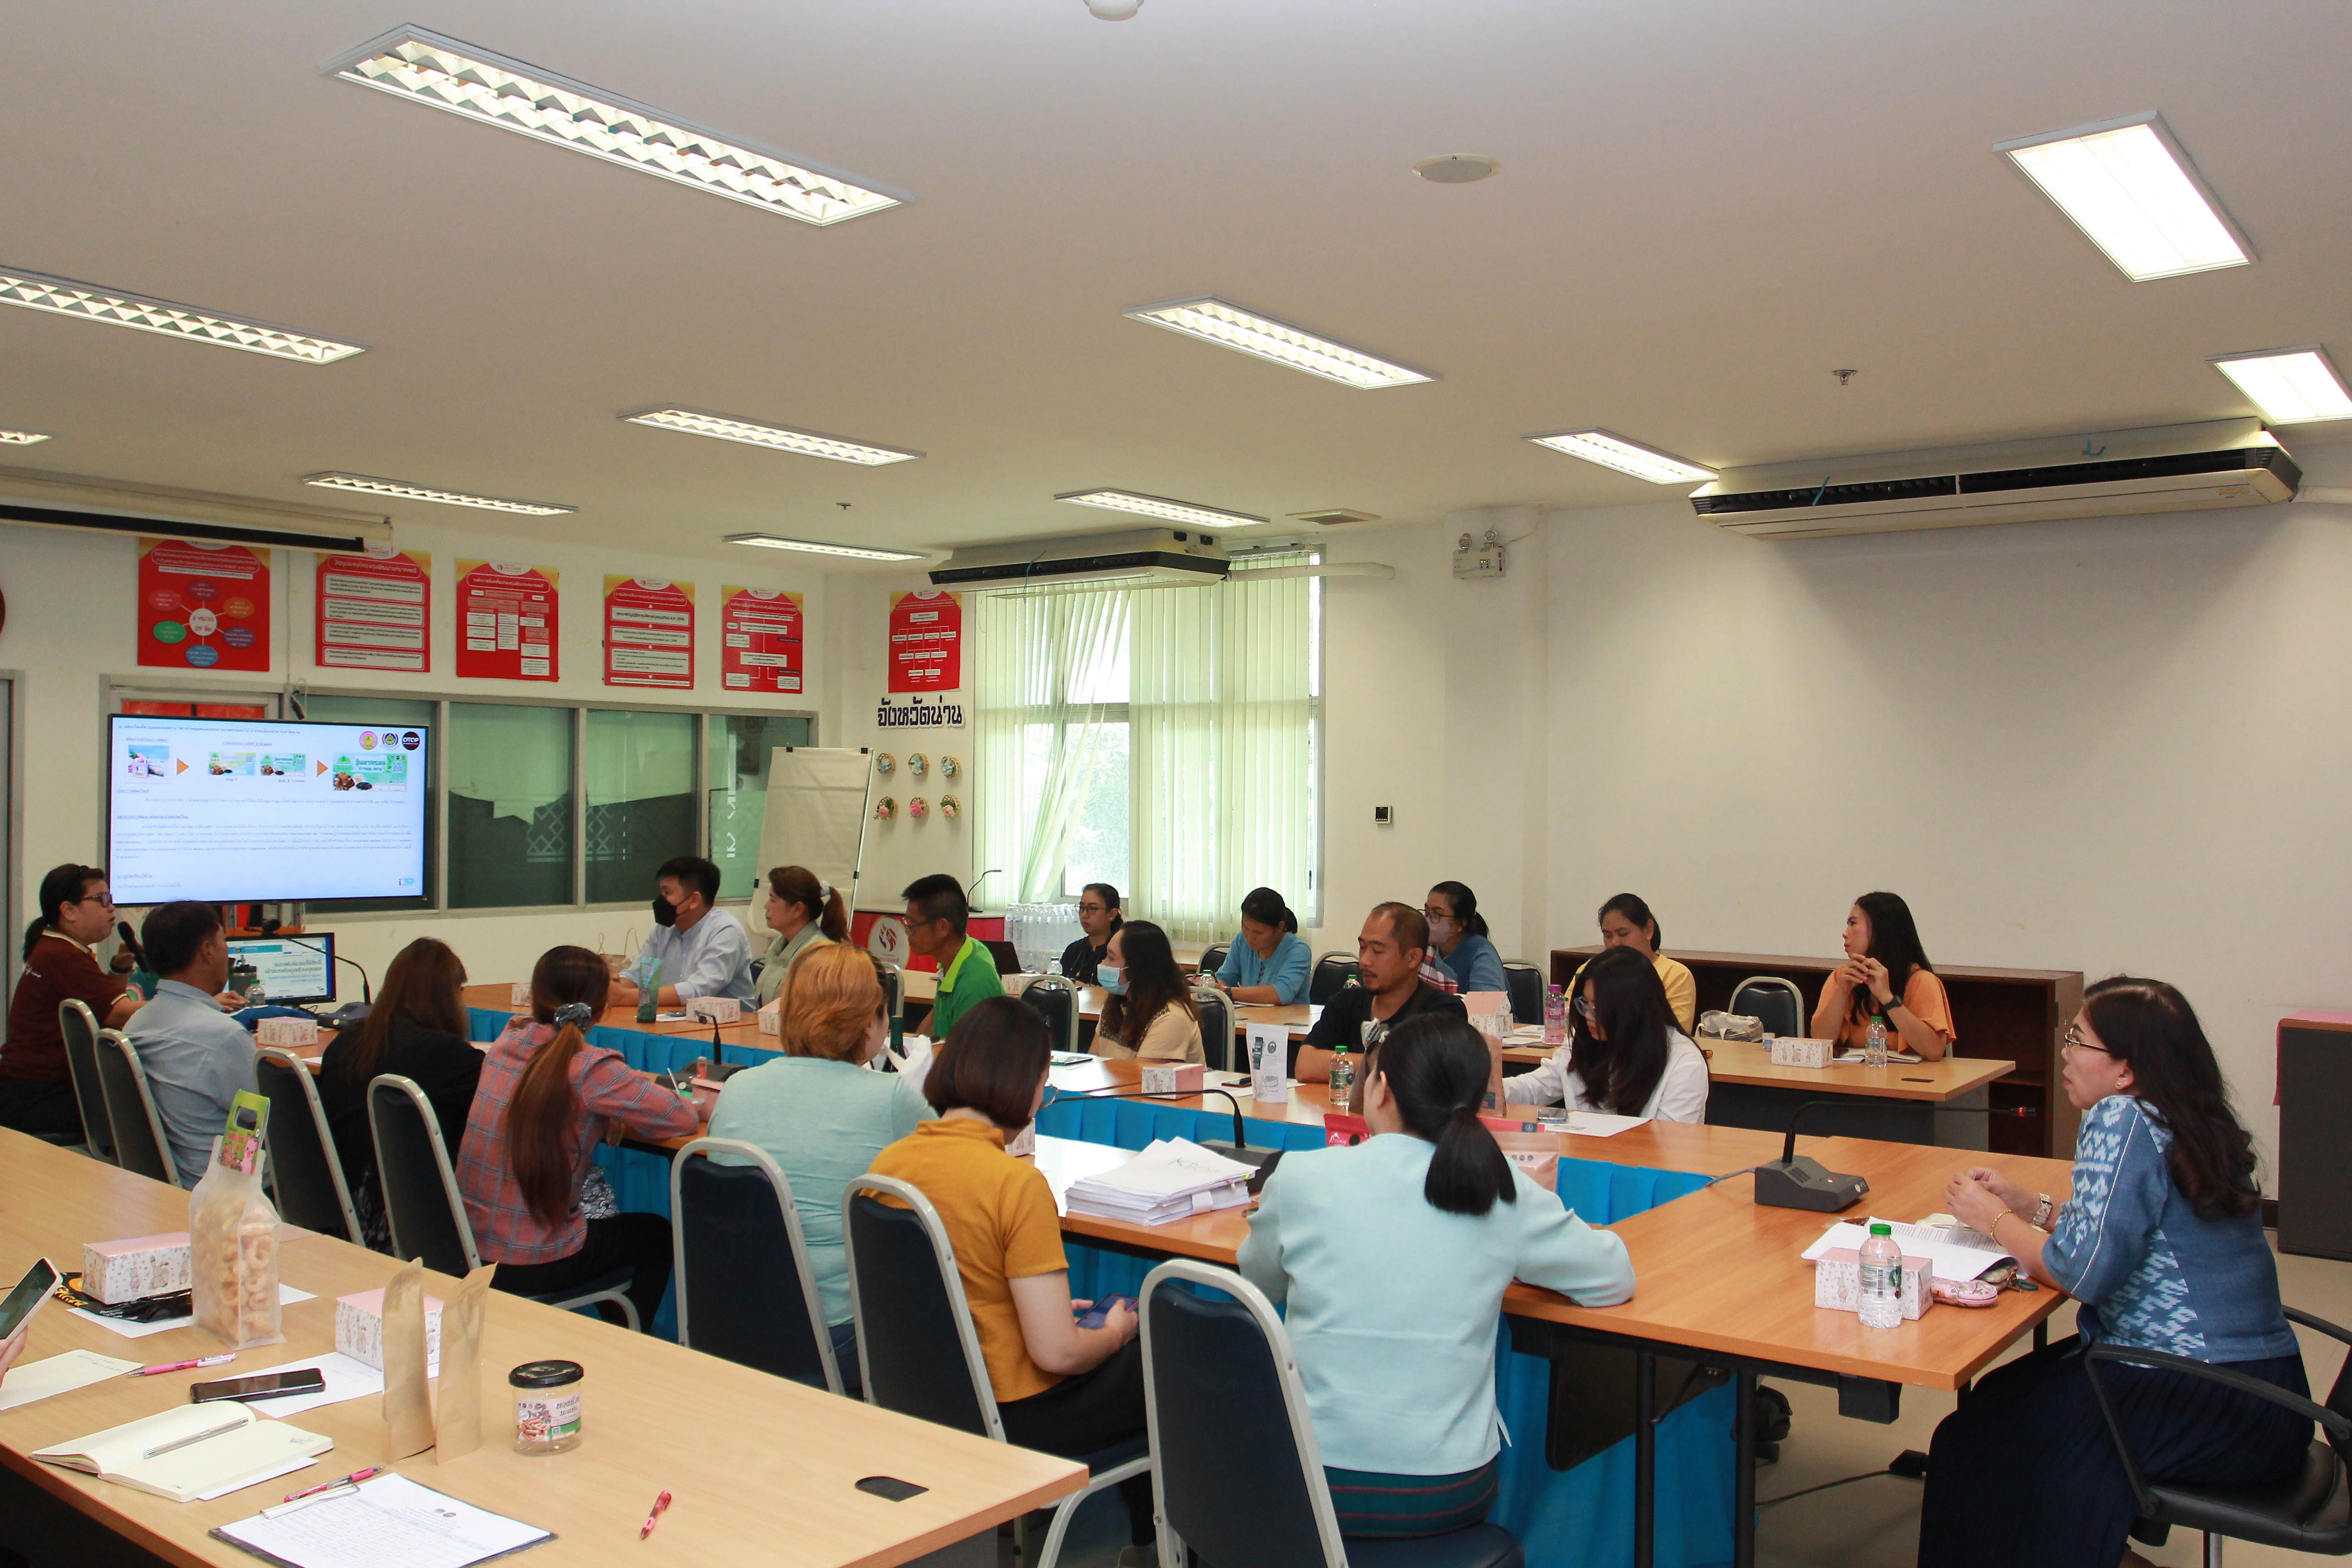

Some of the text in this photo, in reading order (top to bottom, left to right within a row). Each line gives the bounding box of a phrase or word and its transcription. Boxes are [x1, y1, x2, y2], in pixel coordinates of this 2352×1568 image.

[878, 695, 963, 727] จังหวัดน่าน
[355, 758, 386, 767] วุ้นชากรอบ
